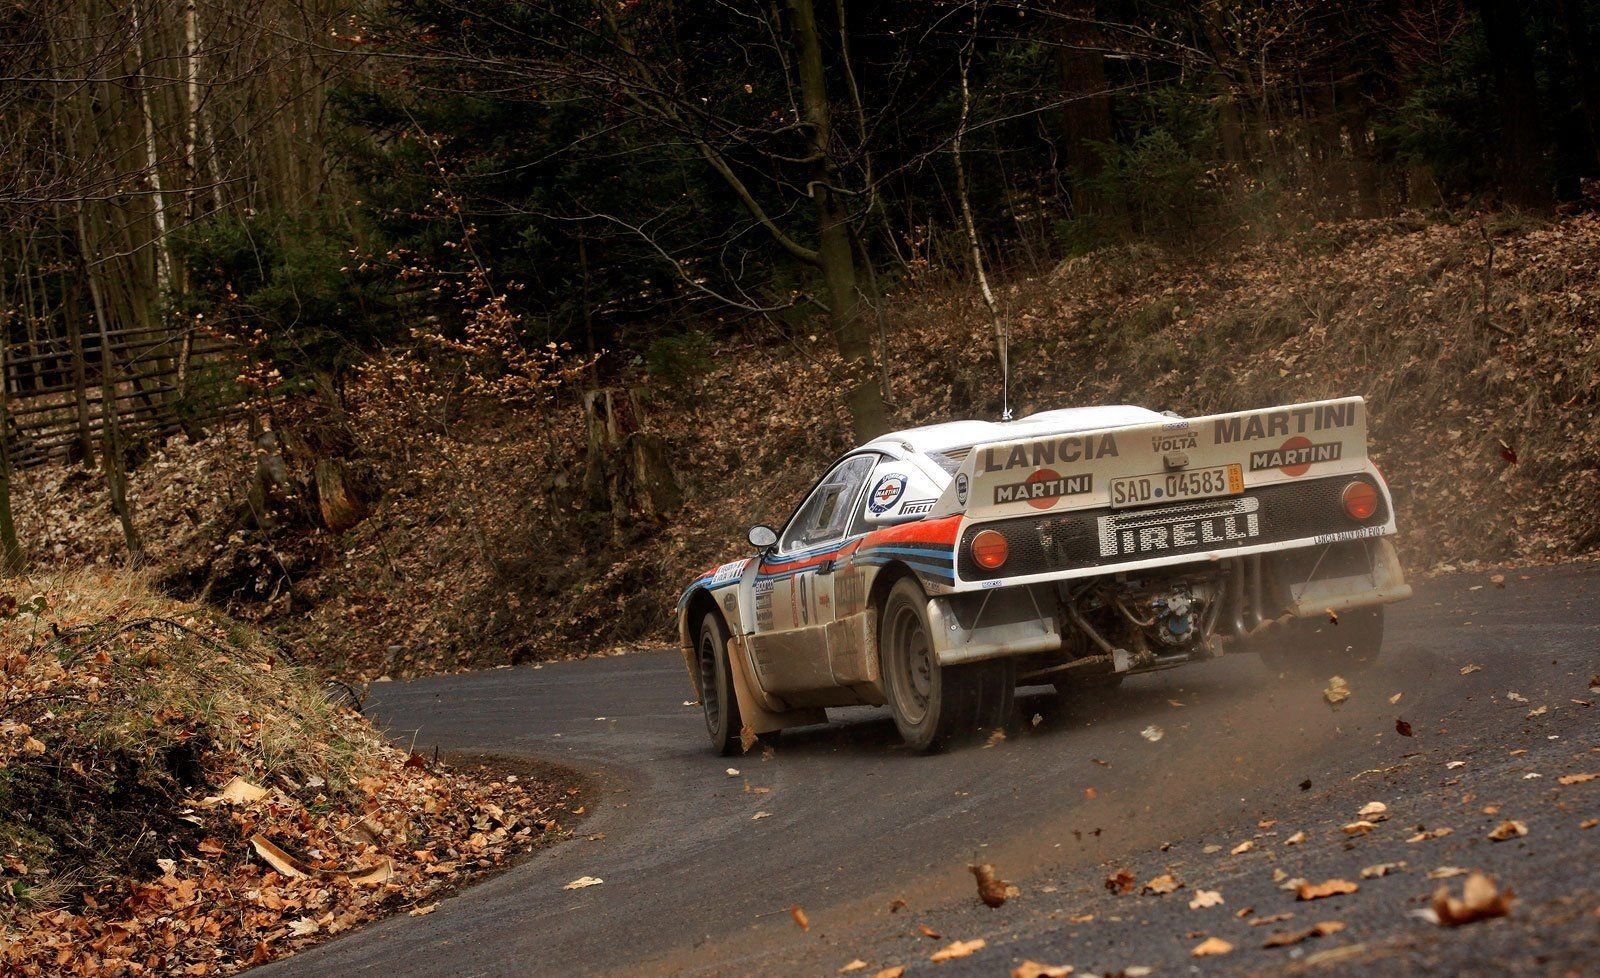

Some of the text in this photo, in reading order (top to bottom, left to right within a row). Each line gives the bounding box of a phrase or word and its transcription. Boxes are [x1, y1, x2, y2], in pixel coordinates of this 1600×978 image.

[1214, 402, 1356, 445] MARTINI
[984, 433, 1119, 473] LANCIA
[1151, 437, 1198, 453] VOLTA
[1252, 444, 1340, 470] MARTINI
[997, 475, 1090, 503] MARTINI
[1114, 470, 1225, 504] SAD 04583
[898, 498, 938, 515] PIRELL
[1097, 496, 1260, 557] PIRELLI
